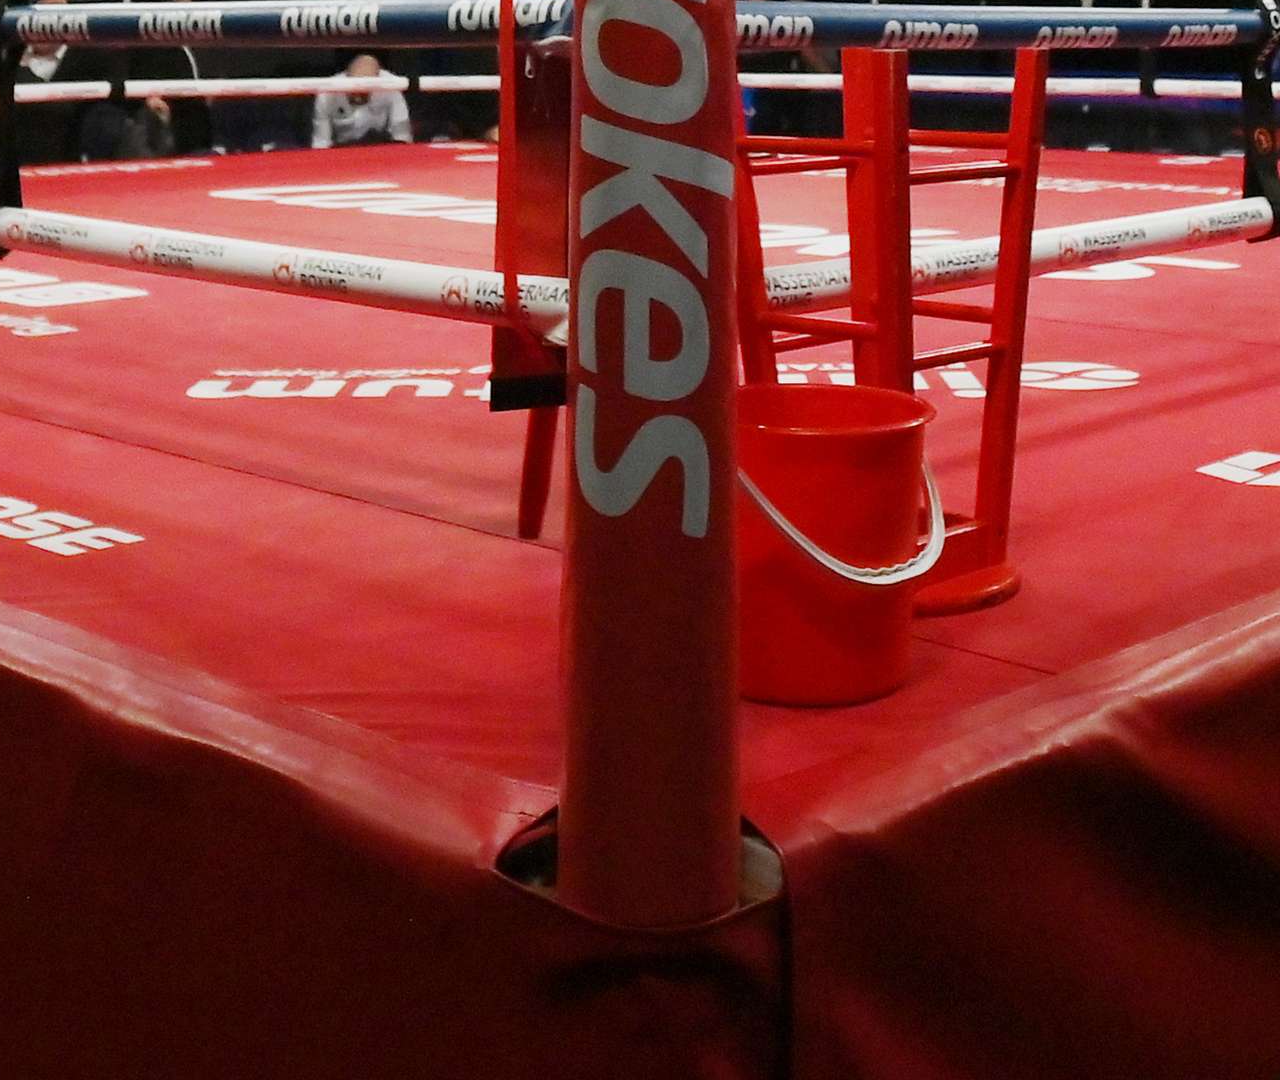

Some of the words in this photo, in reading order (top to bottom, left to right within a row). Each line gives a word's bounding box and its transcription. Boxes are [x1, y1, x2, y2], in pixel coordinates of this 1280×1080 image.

[280, 3, 379, 37] numan
[736, 14, 814, 48] man
[935, 250, 1000, 269] WASSERMA
[476, 278, 569, 304] WASERMAN
